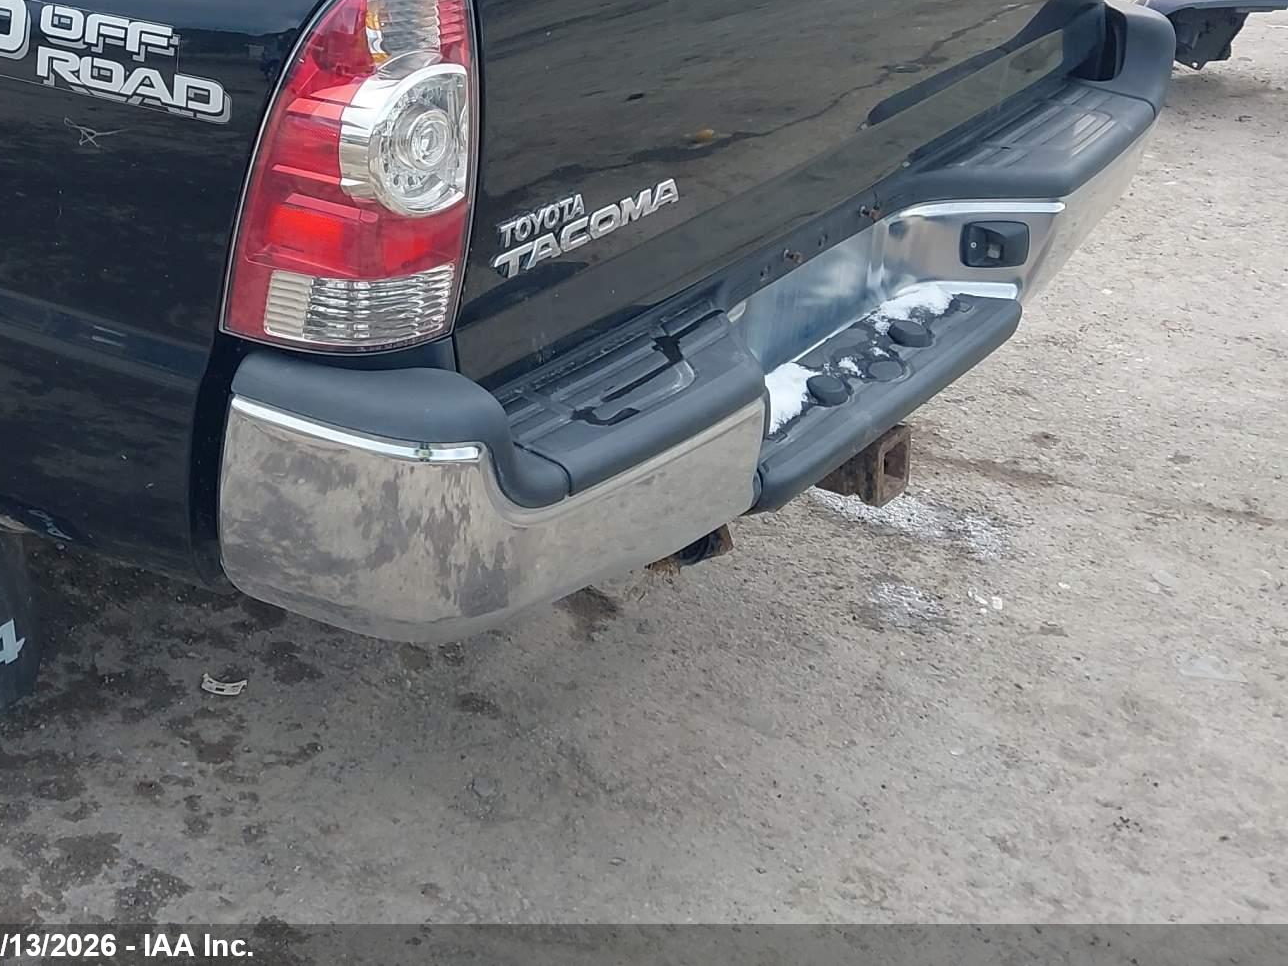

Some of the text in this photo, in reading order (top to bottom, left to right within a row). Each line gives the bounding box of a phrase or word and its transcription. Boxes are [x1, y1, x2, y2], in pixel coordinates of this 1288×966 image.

[40, 3, 180, 62] OFF
[35, 45, 232, 124] ROAD
[491, 177, 680, 279] TACOMA
[498, 193, 586, 248] TOYOTA
